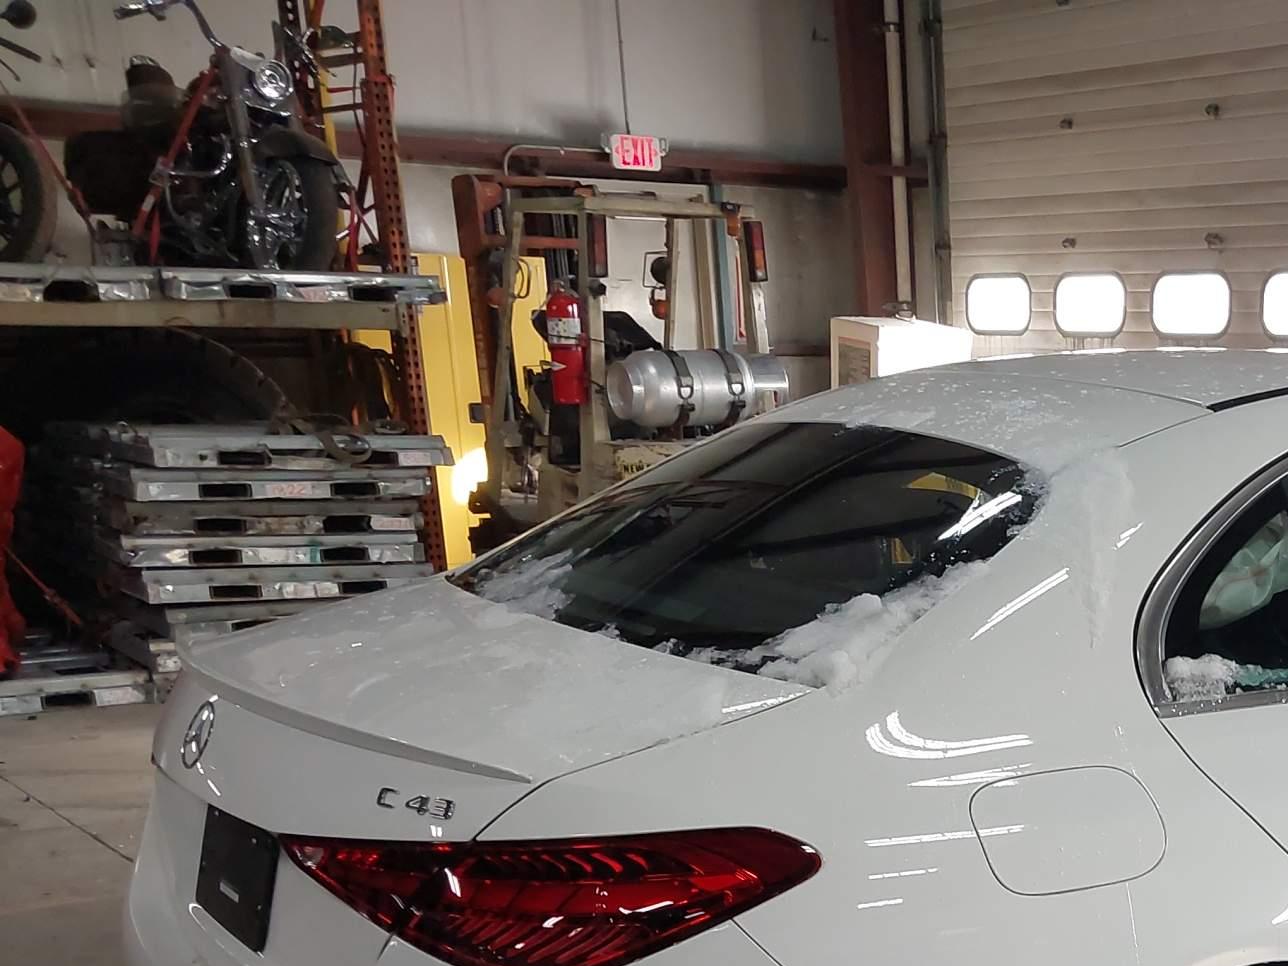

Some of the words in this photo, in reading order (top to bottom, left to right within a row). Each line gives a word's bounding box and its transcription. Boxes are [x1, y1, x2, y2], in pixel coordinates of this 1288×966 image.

[620, 136, 654, 168] EXIT
[376, 787, 400, 809] C
[405, 795, 455, 820] 43
